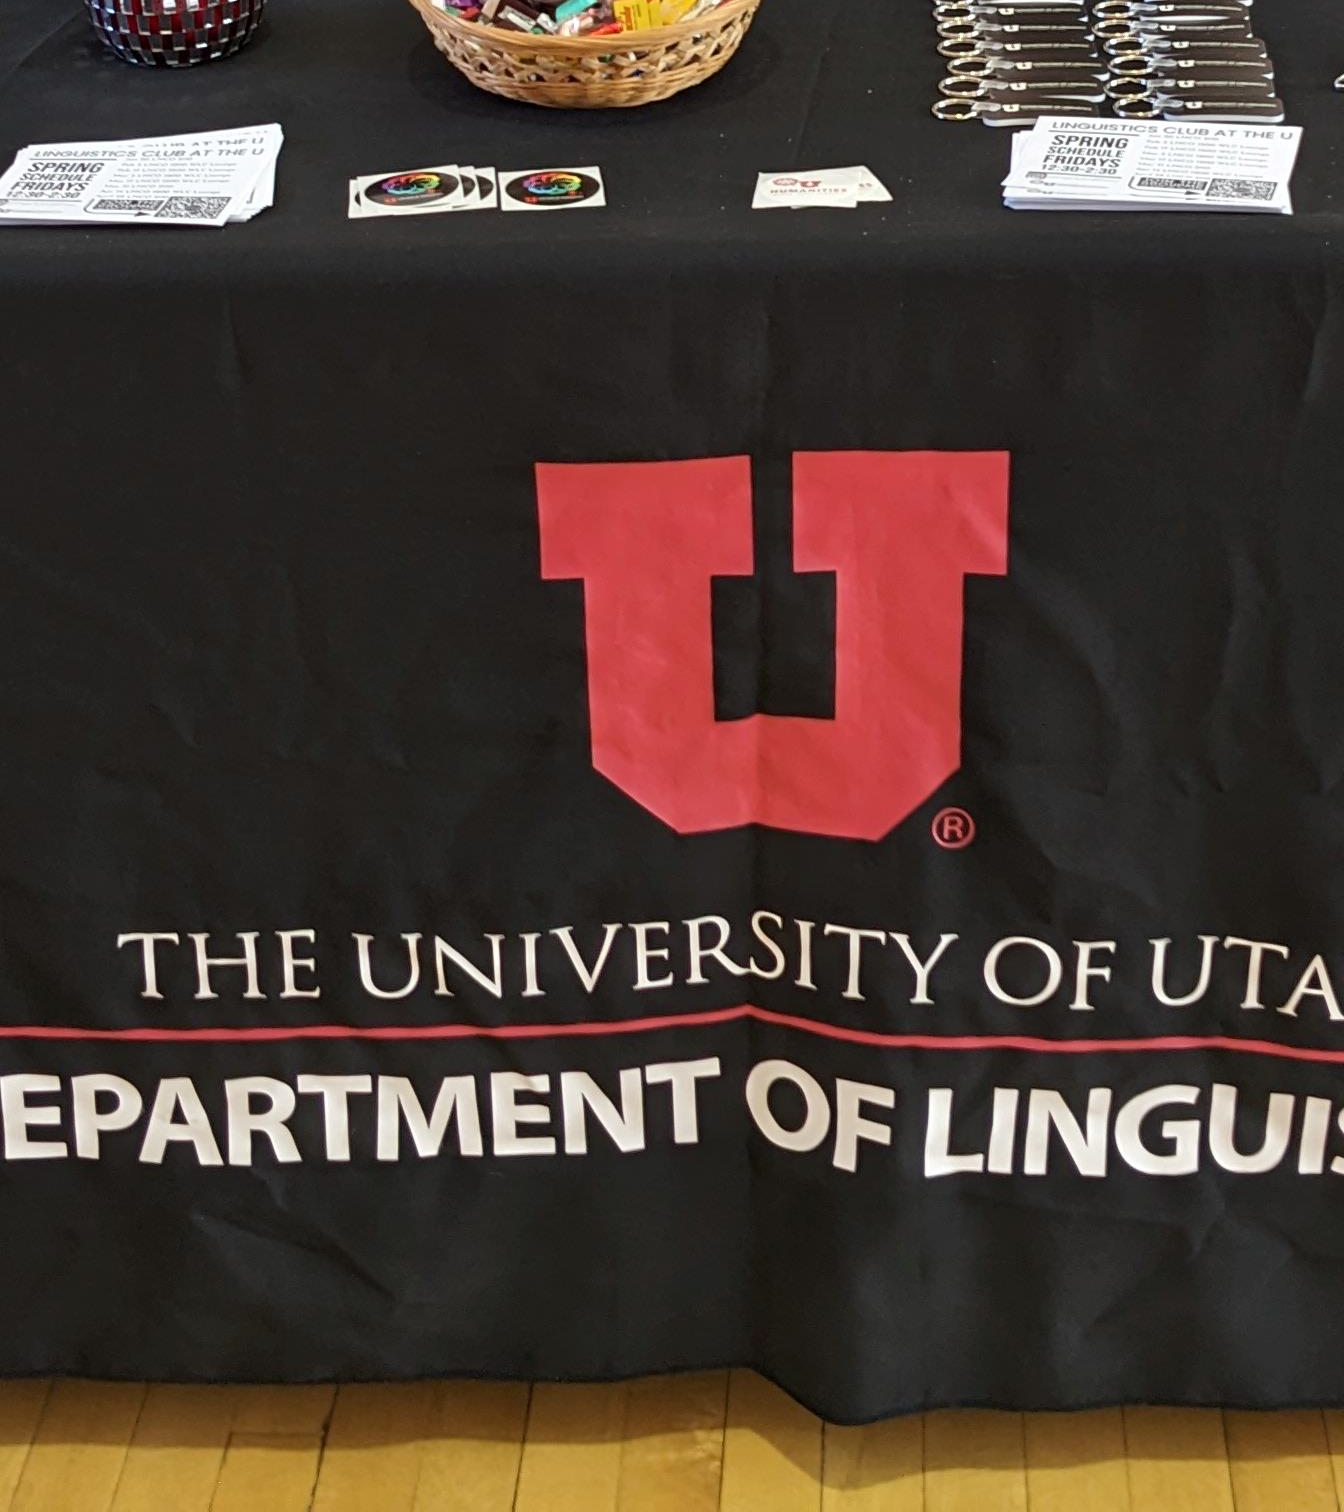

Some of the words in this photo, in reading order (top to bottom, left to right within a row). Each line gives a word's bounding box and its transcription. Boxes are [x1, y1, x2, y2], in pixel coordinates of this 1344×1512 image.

[1052, 121, 1158, 134] LINGUISTICS
[1163, 123, 1210, 136] CLUB
[1216, 129, 1238, 138] AT
[1243, 130, 1276, 140] THE
[1280, 131, 1294, 140] U
[1051, 134, 1129, 149] SPRING
[34, 149, 138, 158] LINGUISTICS
[142, 149, 186, 157] CLUB
[189, 149, 215, 157] AT
[217, 148, 248, 157] THE
[251, 148, 264, 156] U
[1047, 146, 1127, 159] SCHEDULE
[27, 162, 105, 173] SPRING
[1042, 154, 1122, 169] FRIDAYS
[1041, 164, 1118, 175] 12:30-2:30
[19, 172, 97, 182] SCHEDULE
[10, 181, 90, 191] FRIDAYS
[6, 190, 81, 199] 12:30-2:30
[535, 449, 1011, 843] U
[116, 928, 321, 1000] THE
[351, 910, 961, 1006] UNIVERSITY
[983, 934, 1116, 1011] OF
[745, 1058, 896, 1172] OF
